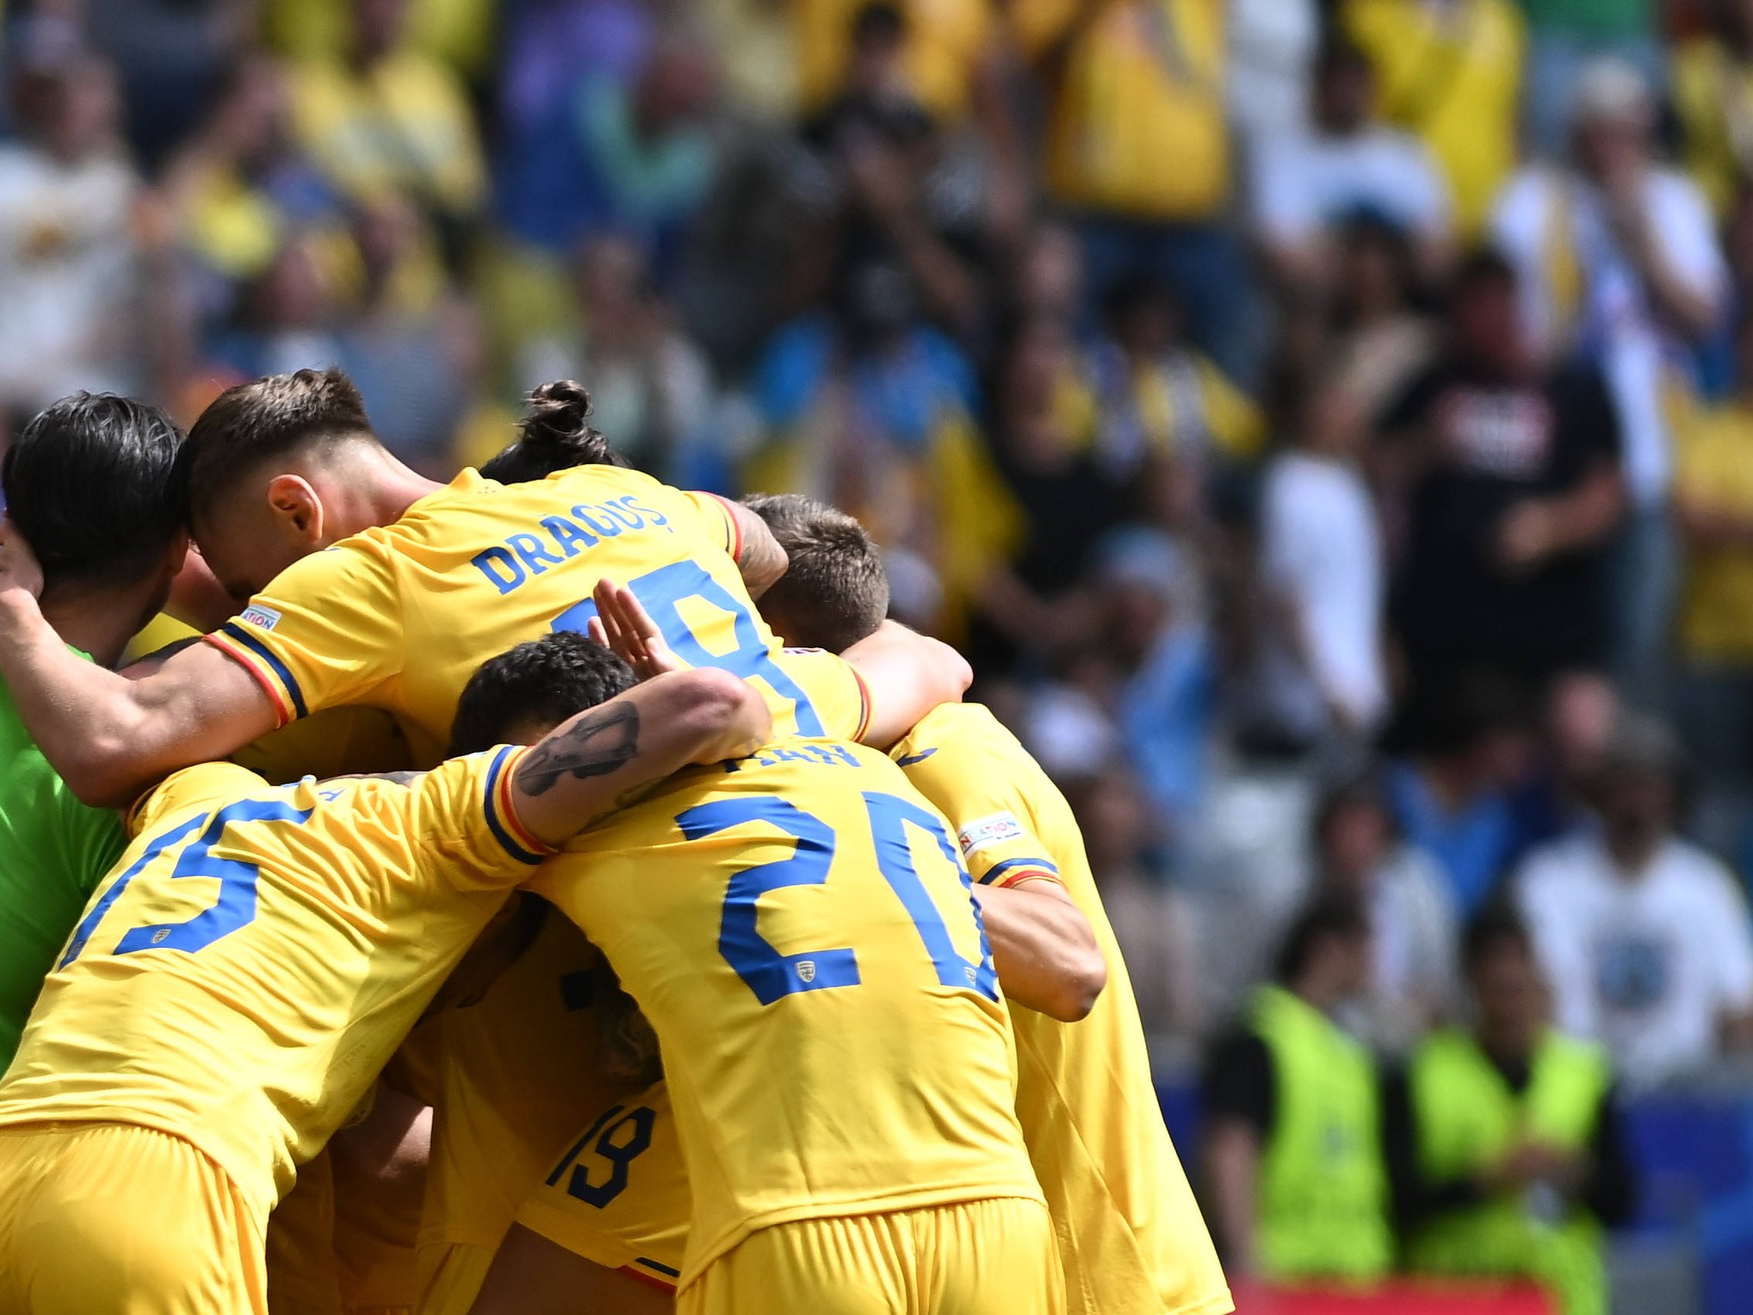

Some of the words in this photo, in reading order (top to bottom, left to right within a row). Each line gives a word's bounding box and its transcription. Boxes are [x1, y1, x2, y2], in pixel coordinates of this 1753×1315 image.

[58, 797, 316, 970] 15
[673, 790, 1001, 1007] 20
[545, 1104, 658, 1210] 19
